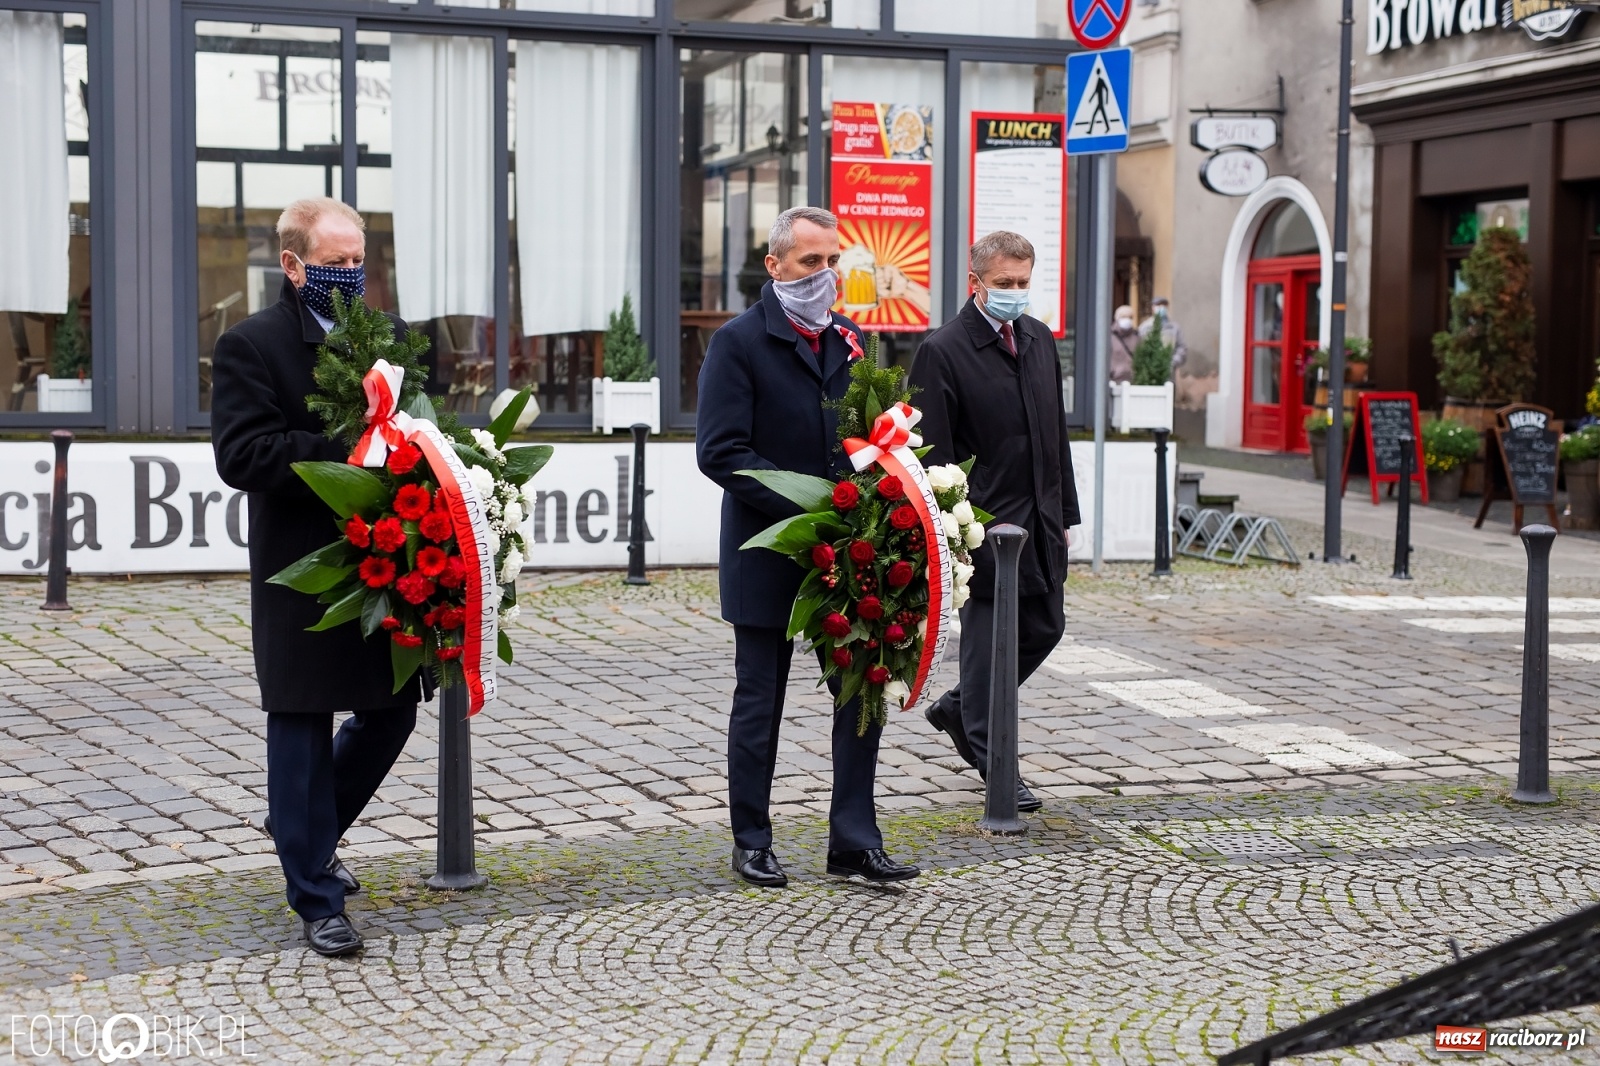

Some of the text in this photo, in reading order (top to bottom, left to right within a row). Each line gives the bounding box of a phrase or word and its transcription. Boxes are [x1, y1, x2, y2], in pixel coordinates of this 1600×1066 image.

[988, 120, 1052, 139] LUNCH
[845, 163, 920, 191] Promocja
[856, 192, 908, 205] DWA PIWA
[838, 204, 925, 217] W CENIE JEDNEGO
